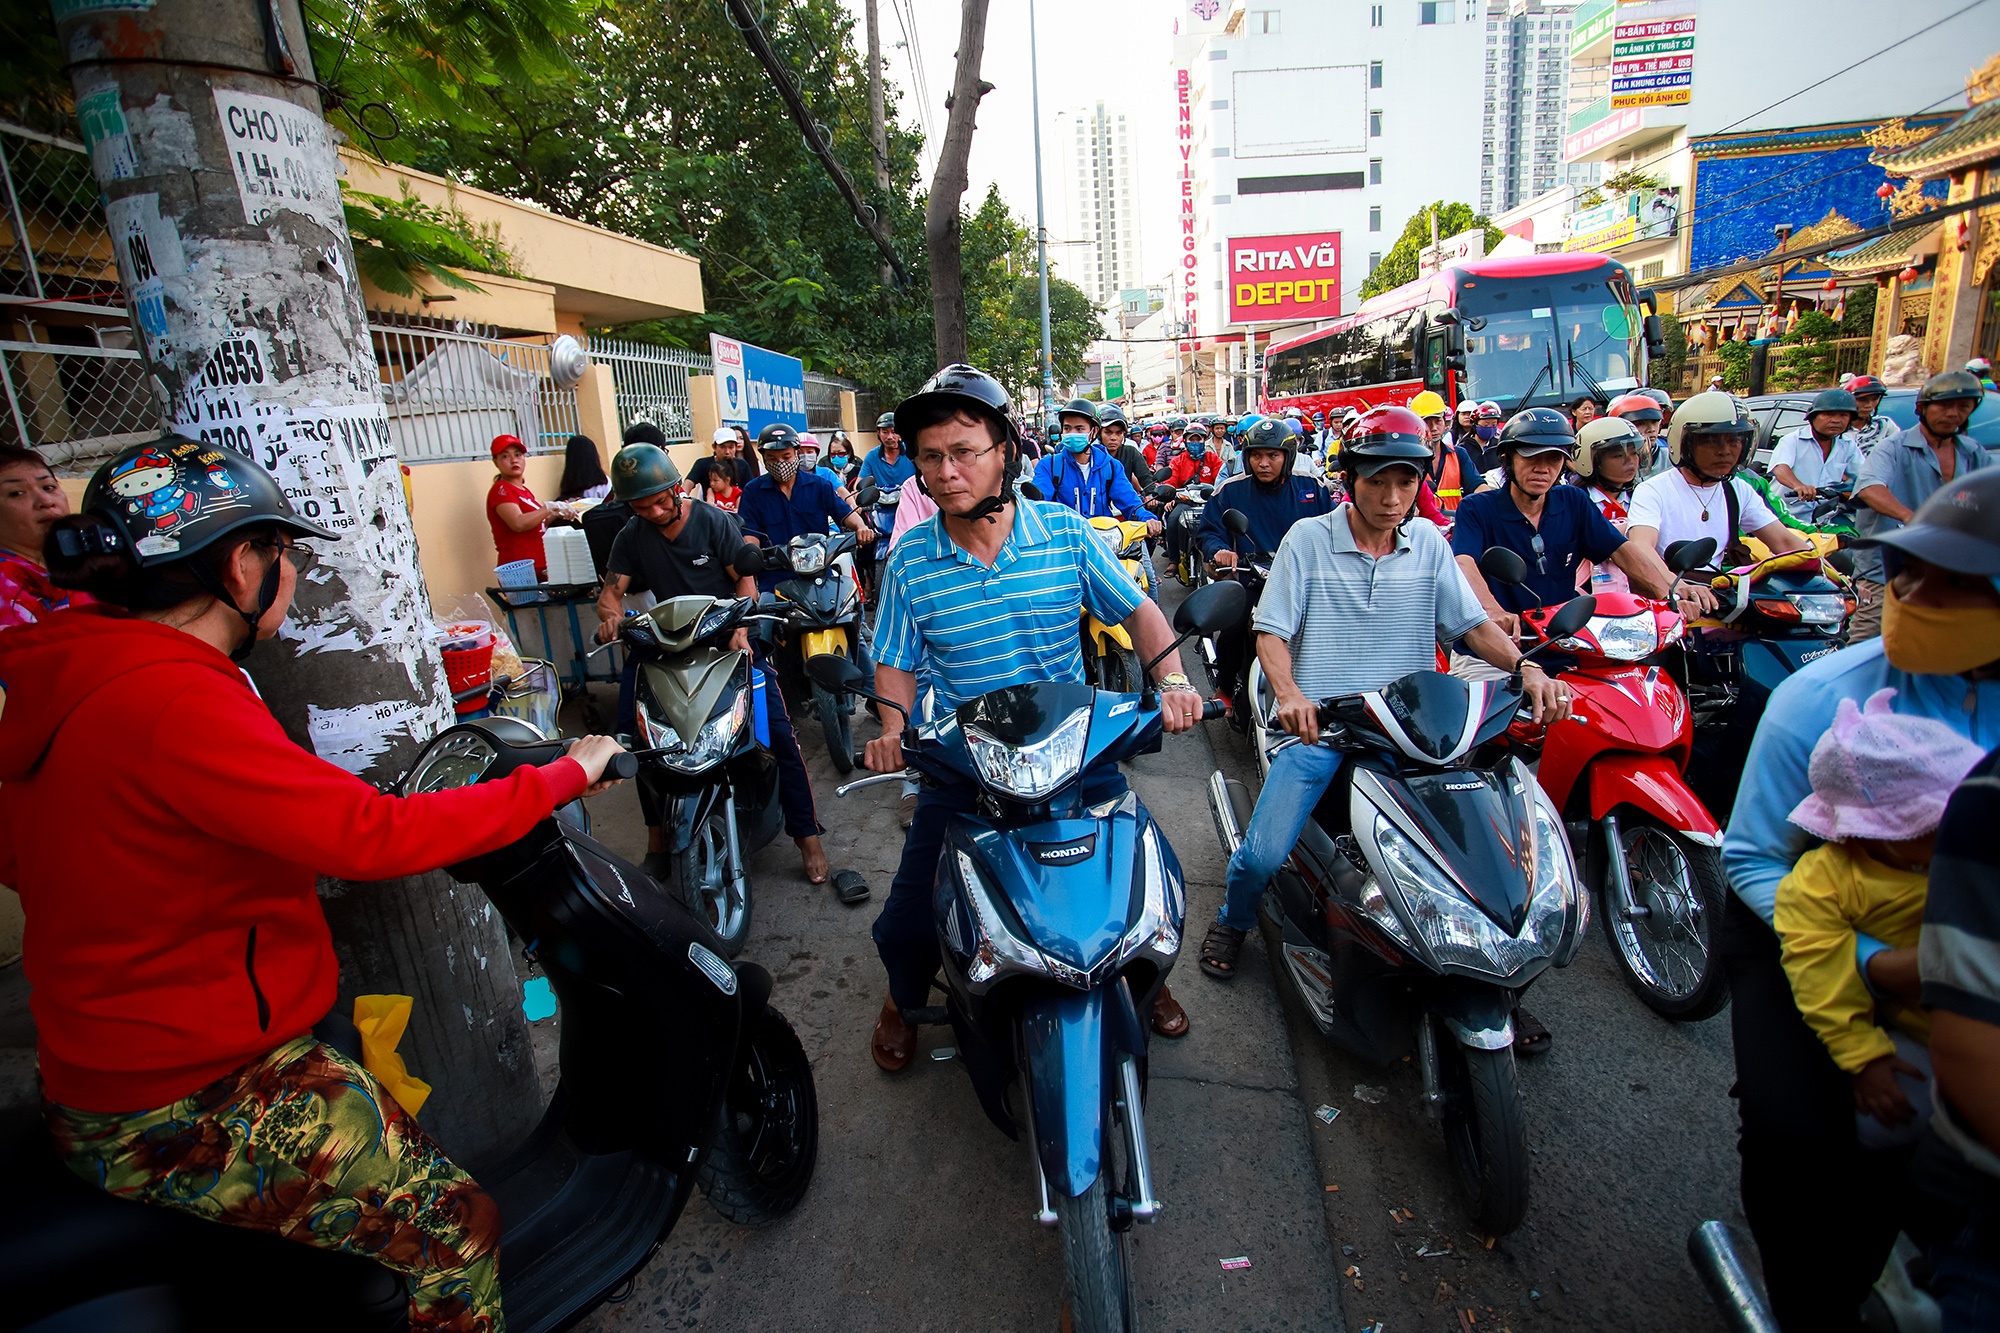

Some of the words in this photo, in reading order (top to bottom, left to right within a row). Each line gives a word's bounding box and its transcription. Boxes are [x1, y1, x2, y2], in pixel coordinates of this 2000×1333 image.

[1616, 24, 1645, 38] IN-BÁN
[1647, 21, 1672, 35] THIỆP
[1673, 19, 1694, 32] CƯỚI
[1628, 43, 1644, 53] ẢNH
[1657, 40, 1680, 50] THUẬT
[1613, 62, 1627, 74] BÁN
[1628, 63, 1639, 72] PIN
[1678, 57, 1691, 67] USB
[1613, 80, 1629, 89] BÁN
[1630, 79, 1655, 88] KHUNG
[1656, 76, 1671, 85] CÁC
[1673, 75, 1690, 84] LOẠI
[228, 105, 279, 143] CHO
[1236, 279, 1335, 306] DEPOT
[338, 416, 373, 463] VAY
[1445, 781, 1484, 790] HONDA
[1040, 845, 1089, 859] HONDA
